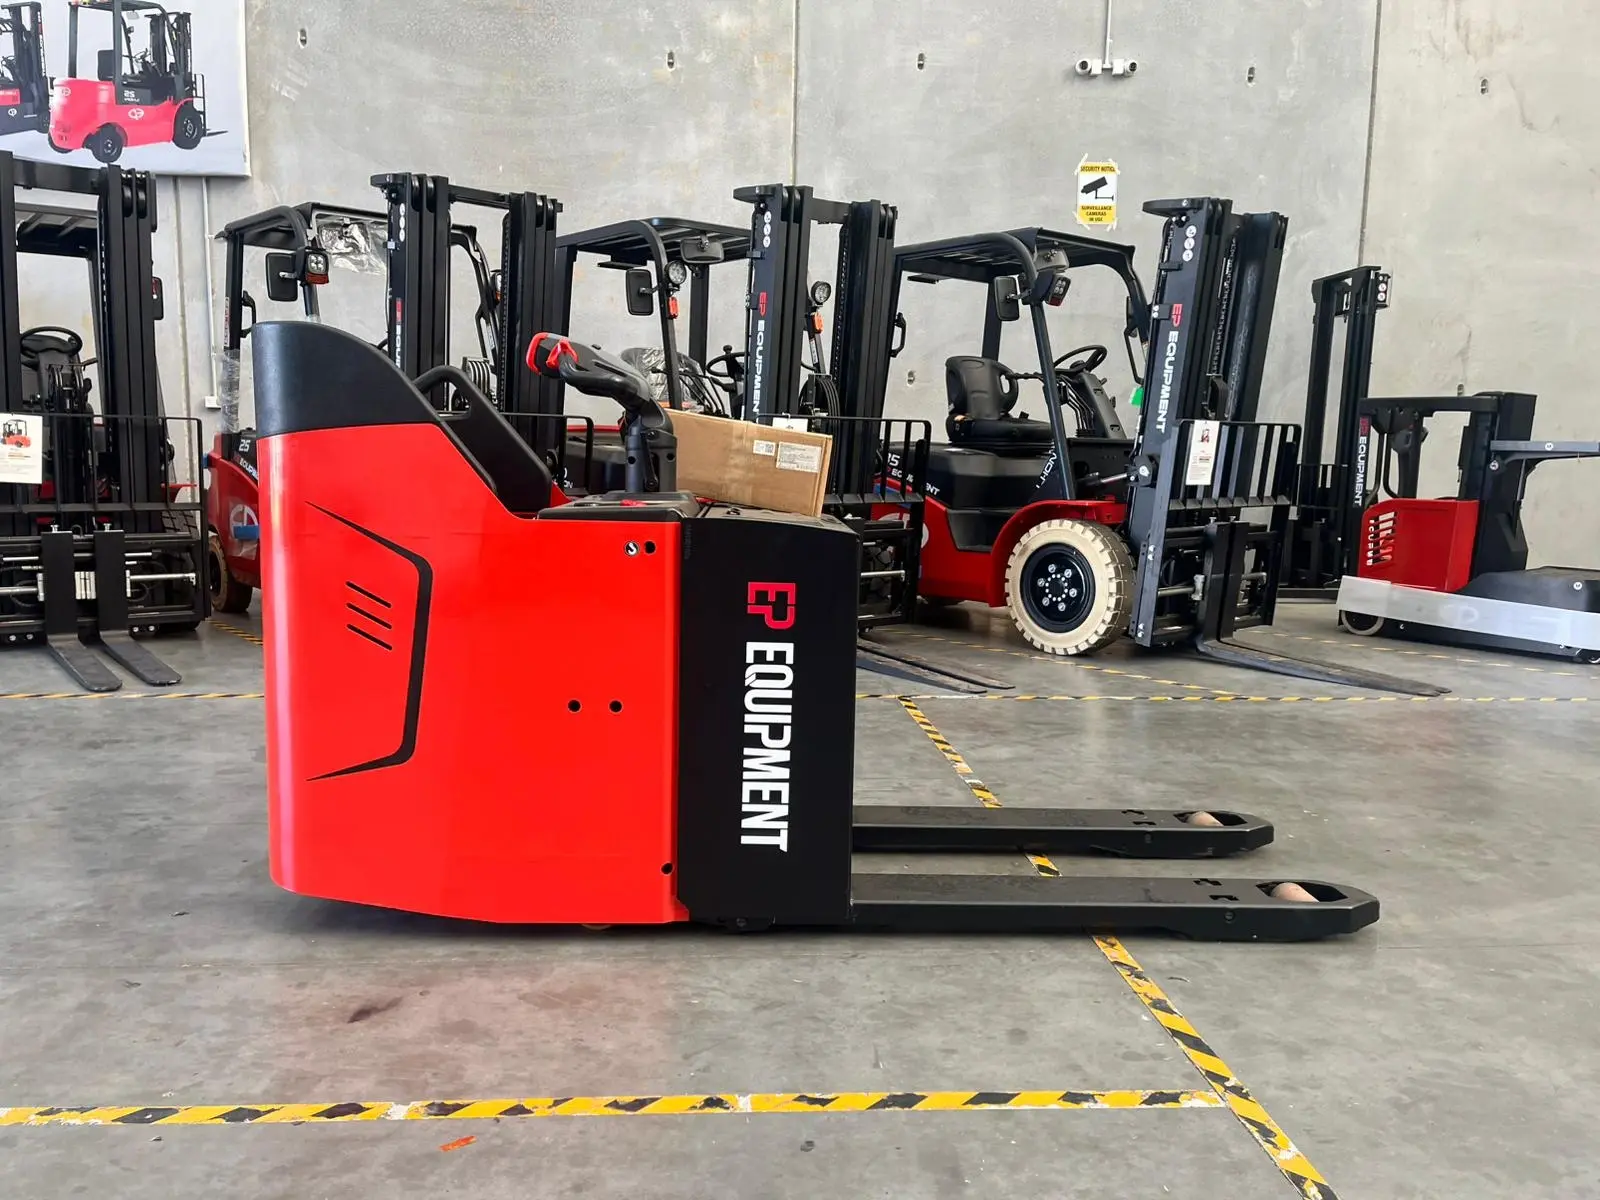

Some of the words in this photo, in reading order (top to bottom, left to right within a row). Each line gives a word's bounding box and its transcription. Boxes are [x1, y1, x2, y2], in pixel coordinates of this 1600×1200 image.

[759, 292, 768, 317] EP
[1171, 303, 1183, 328] EP
[1155, 330, 1179, 434] EQUIPMENT
[239, 440, 251, 452] 25
[1354, 436, 1367, 507] EQUIPMENT
[746, 582, 797, 630] EP
[740, 641, 795, 853] EQUIPMENT
